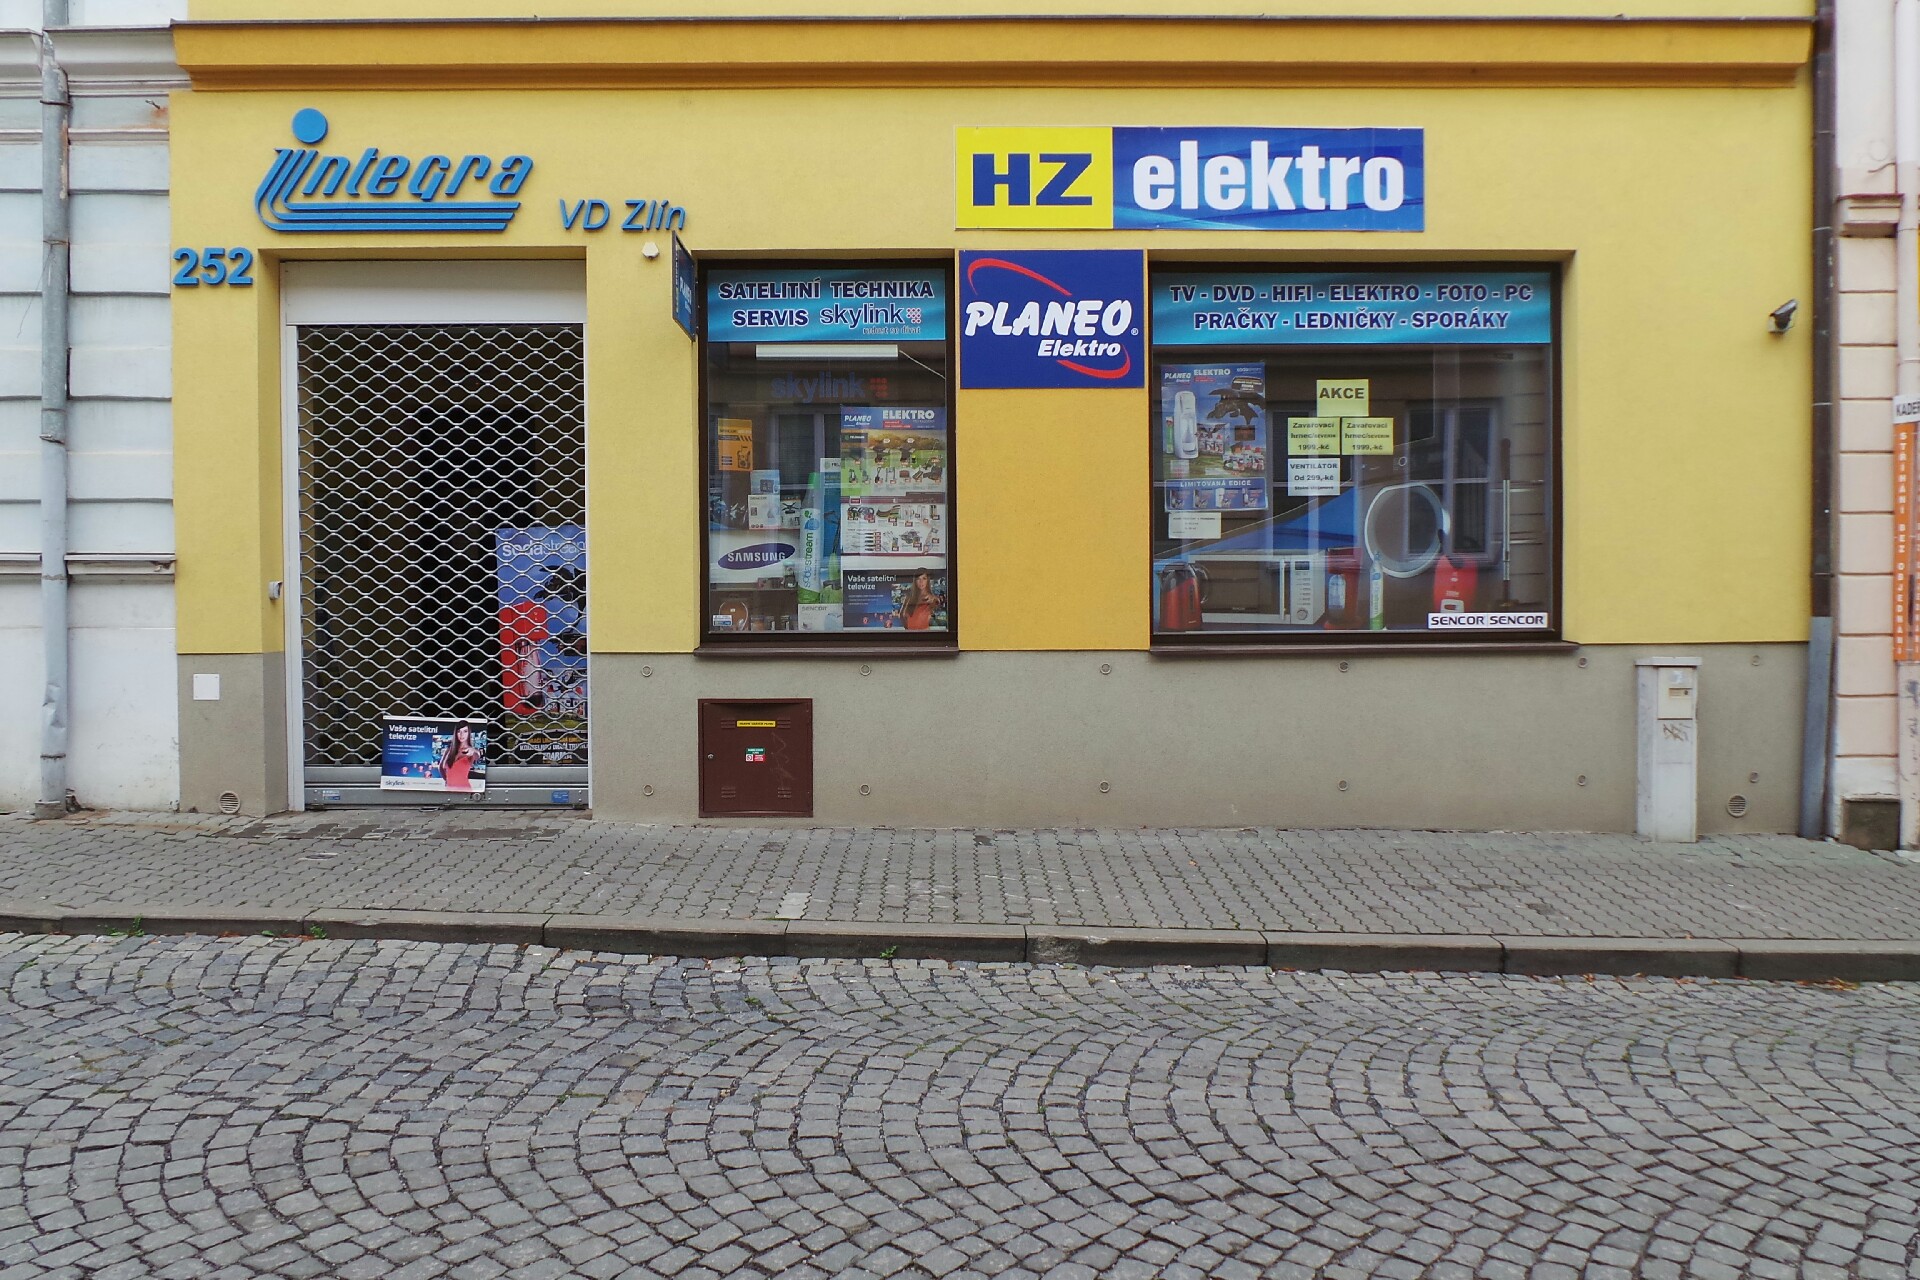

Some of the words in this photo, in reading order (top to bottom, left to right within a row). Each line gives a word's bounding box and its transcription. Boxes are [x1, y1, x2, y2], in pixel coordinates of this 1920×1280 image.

[256, 108, 534, 213] integra
[972, 153, 1092, 206] HZ
[1133, 140, 1404, 211] elektro
[560, 199, 609, 231] VD
[621, 199, 686, 231] Zlín
[173, 247, 253, 286] 252
[718, 277, 821, 299] SATELITNÍ
[830, 281, 934, 298] TECHNIKA
[1170, 284, 1195, 302] TV
[1212, 284, 1255, 302] DVD
[1271, 284, 1313, 302] HIFI
[1329, 284, 1419, 302] ELEKTRO
[1437, 284, 1487, 301] FOTO
[1504, 284, 1533, 301] PC
[732, 309, 809, 327] SERVIS
[820, 303, 905, 328] skylink
[964, 300, 1134, 337] PLANEO
[1194, 307, 1279, 330] PRAČKY
[1294, 307, 1396, 329] LEDNIČKY
[1412, 306, 1509, 329] SPORÁKY
[1037, 339, 1121, 357] Elektro
[1193, 368, 1231, 376] ELEKTRO
[771, 371, 865, 403] skylink
[1319, 388, 1364, 399] AKCE
[883, 410, 935, 420] ELEKTRO
[727, 552, 786, 562] SAMSUNG
[803, 532, 814, 588] sodastream
[1431, 616, 1485, 626] SENCOR
[1489, 615, 1544, 625] SENCOR
[388, 724, 406, 732] Vaše
[408, 725, 438, 733] satelitní
[388, 733, 417, 741] televize
